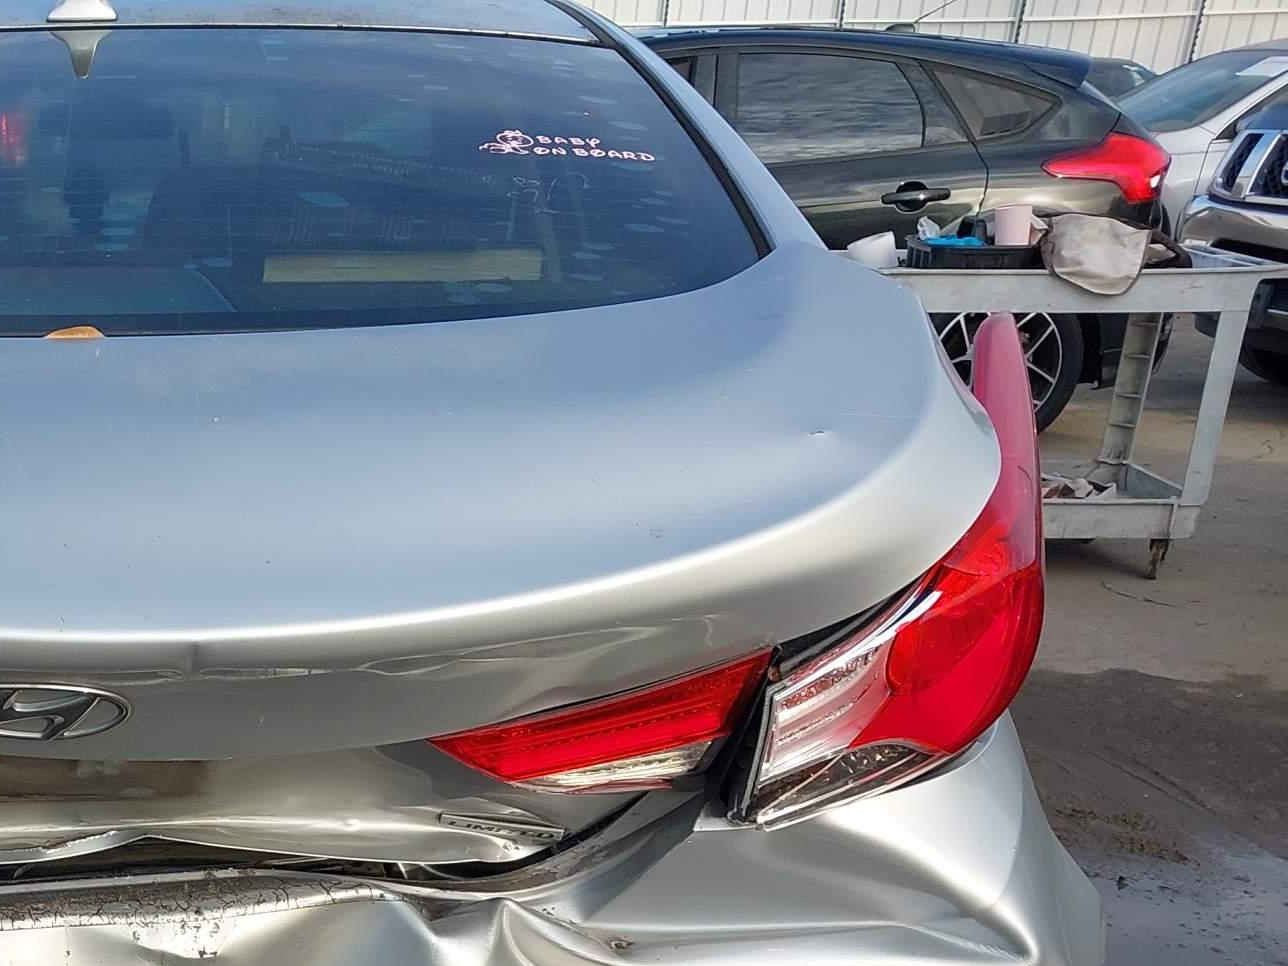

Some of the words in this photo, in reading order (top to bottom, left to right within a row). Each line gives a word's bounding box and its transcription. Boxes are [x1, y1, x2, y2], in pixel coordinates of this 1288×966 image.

[535, 135, 600, 148] BABY
[533, 147, 567, 156] ON
[572, 148, 656, 161] BOARD
[448, 820, 554, 839] LIMITED
